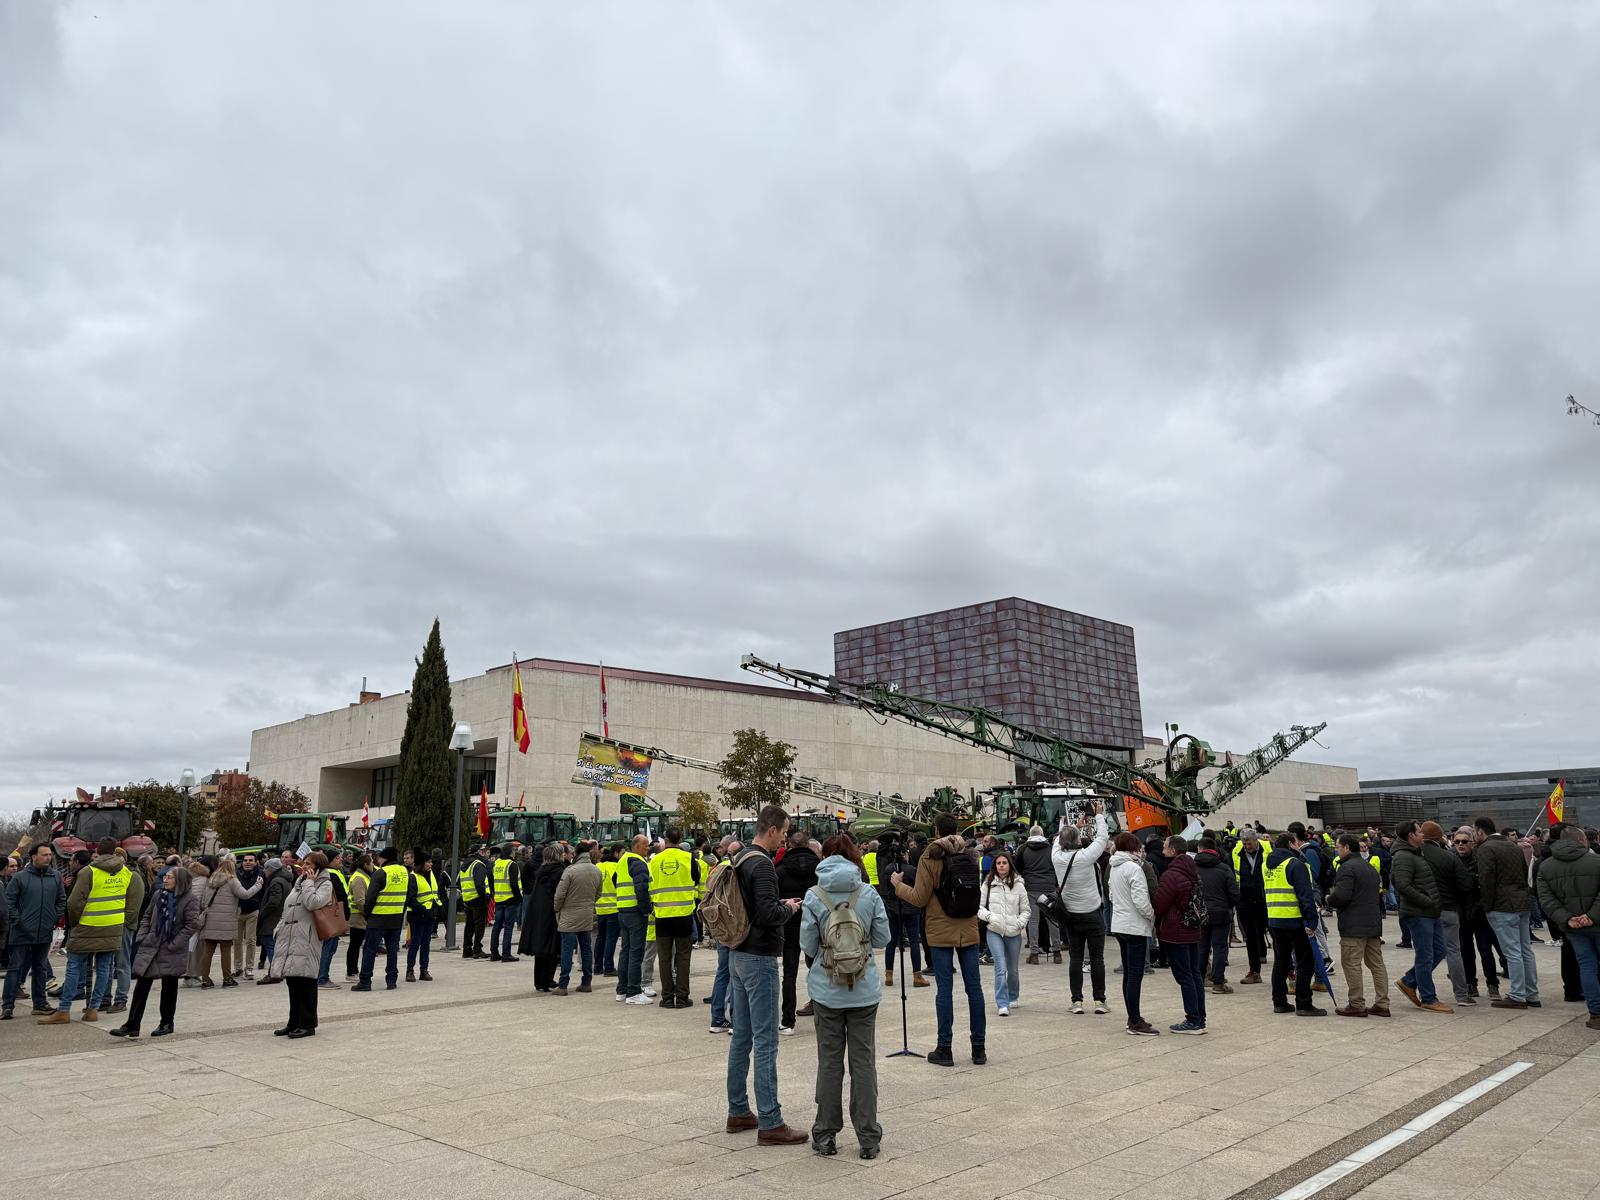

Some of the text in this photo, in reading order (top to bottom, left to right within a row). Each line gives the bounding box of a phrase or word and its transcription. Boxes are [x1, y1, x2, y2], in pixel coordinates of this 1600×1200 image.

[595, 764, 615, 773] CAMPO
[593, 773, 614, 783] CIUDAD
[625, 779, 643, 788] COME
